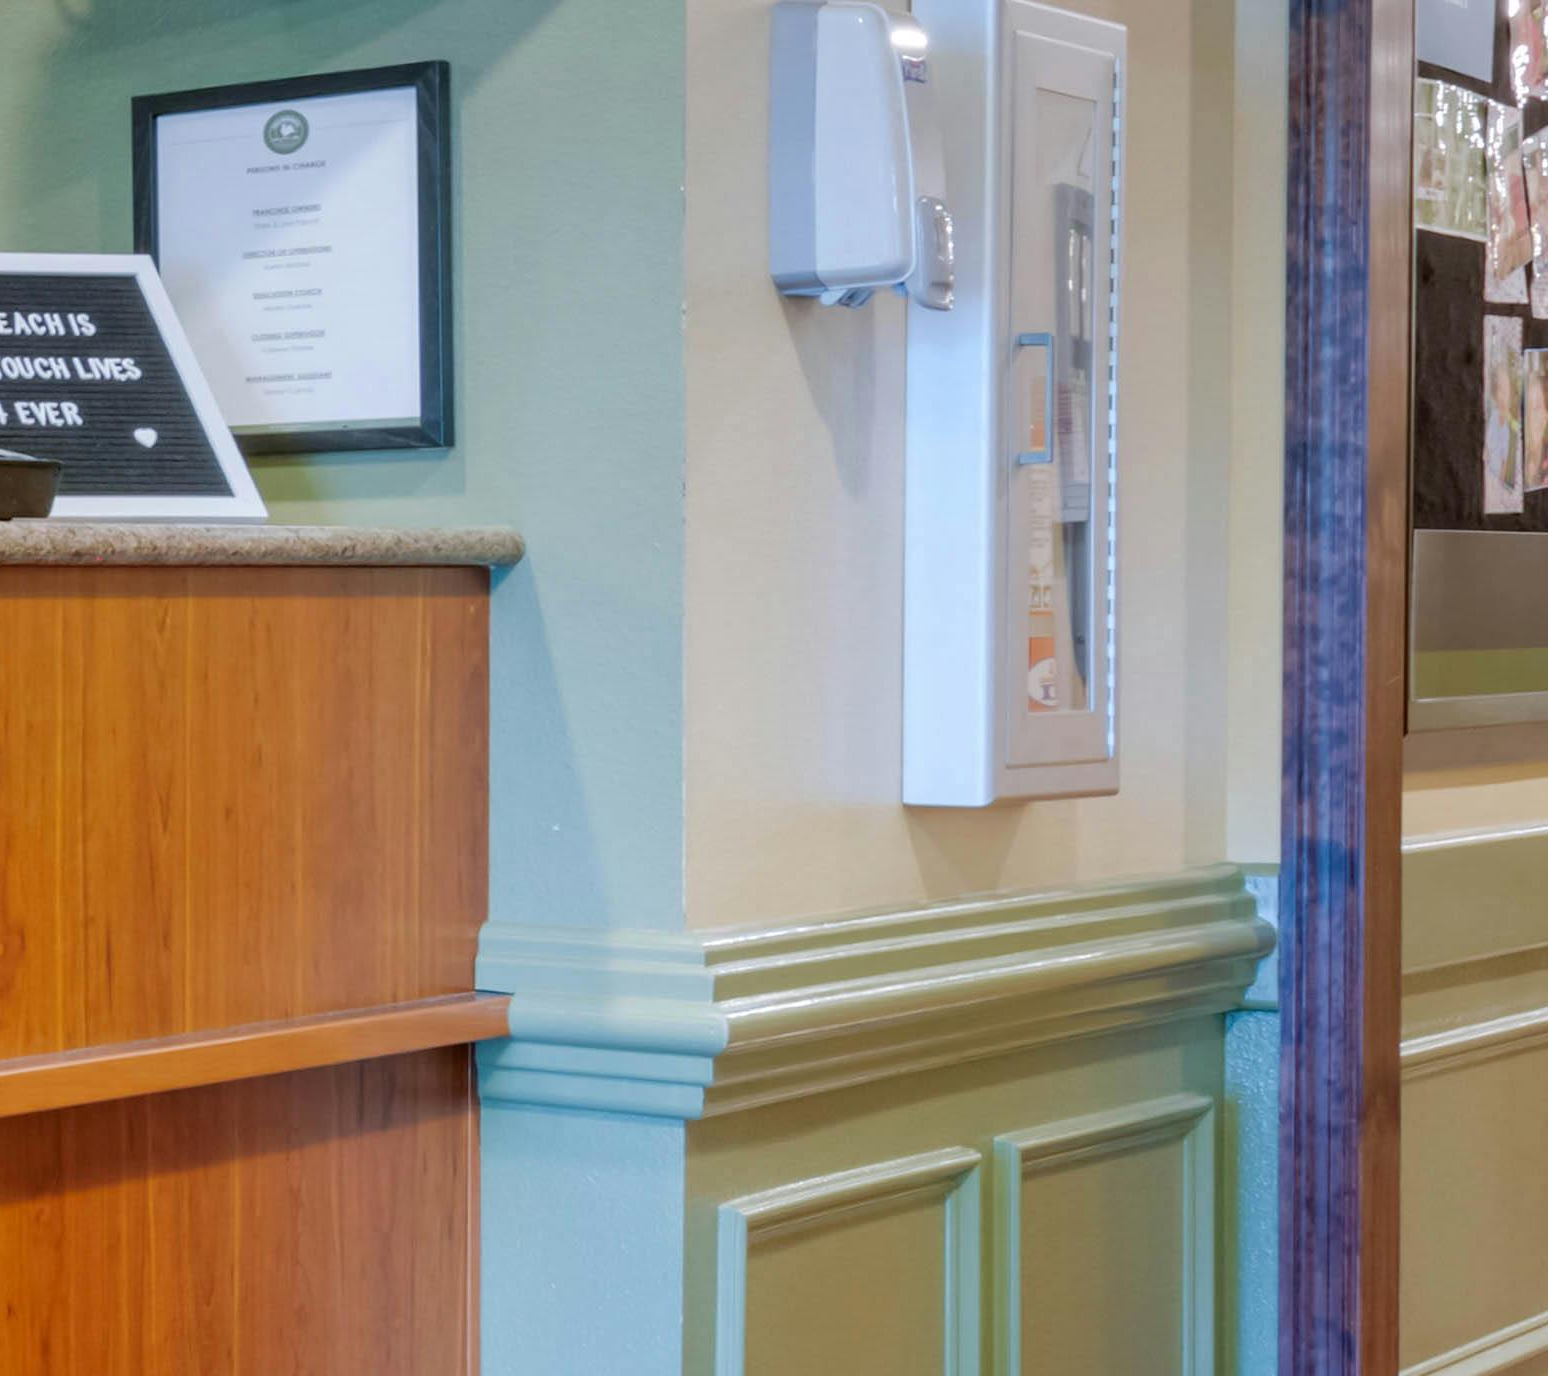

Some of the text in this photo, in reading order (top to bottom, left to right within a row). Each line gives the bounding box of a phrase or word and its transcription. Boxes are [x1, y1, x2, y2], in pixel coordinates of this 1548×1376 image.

[69, 313, 96, 336] IS
[74, 356, 142, 382] LIVES
[14, 400, 84, 426] EVER
